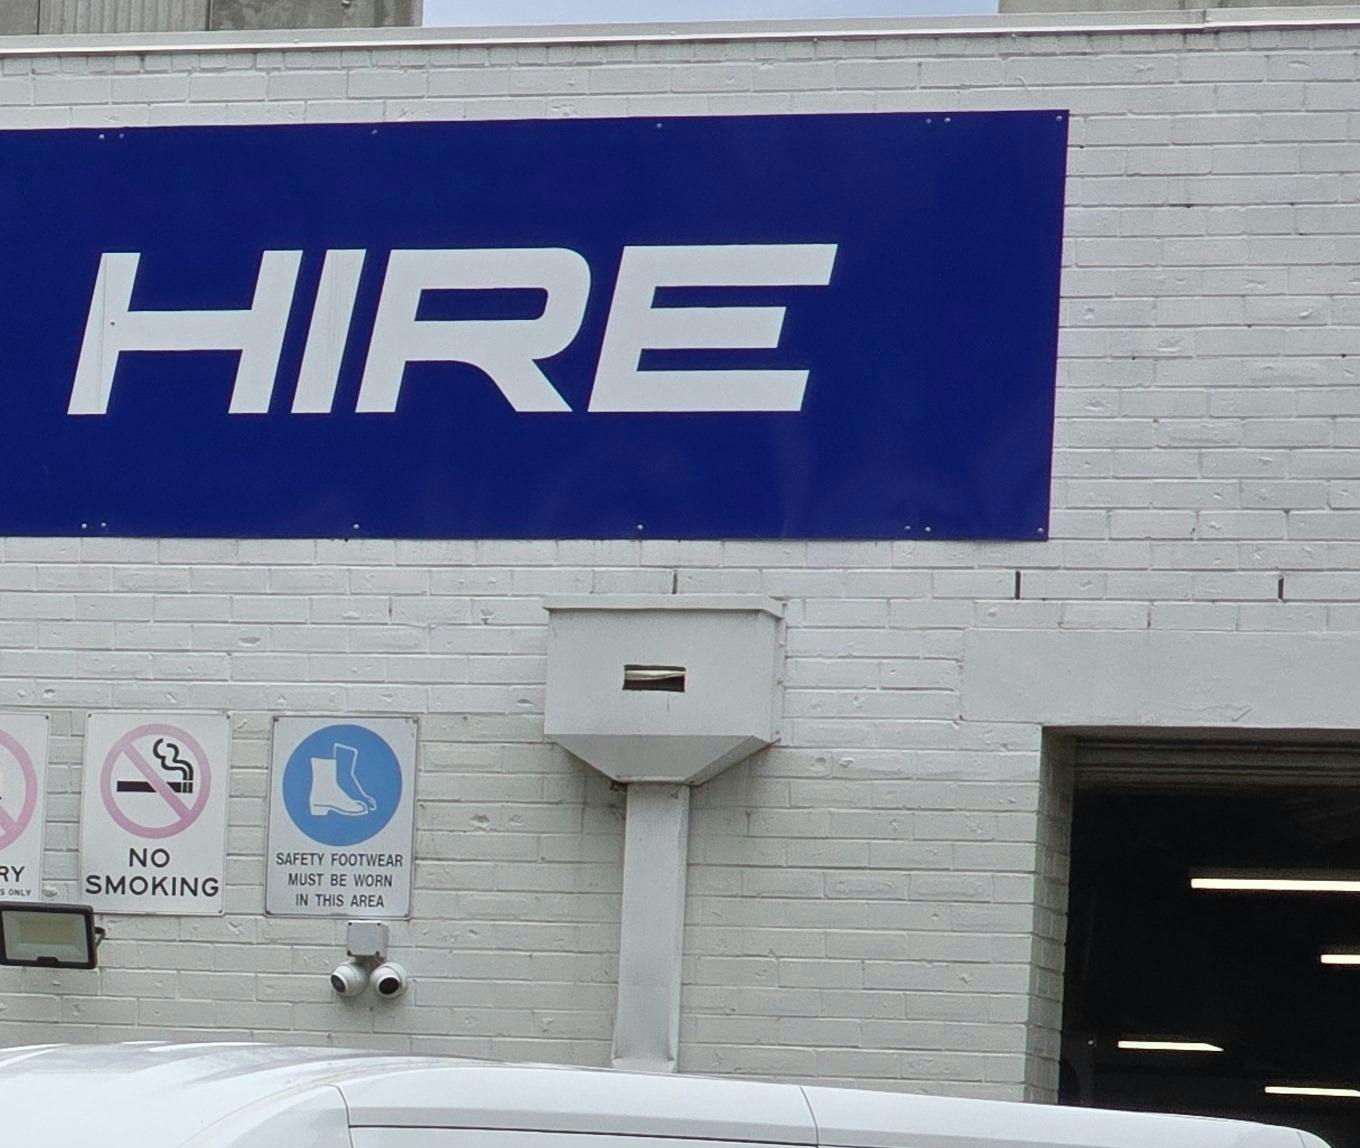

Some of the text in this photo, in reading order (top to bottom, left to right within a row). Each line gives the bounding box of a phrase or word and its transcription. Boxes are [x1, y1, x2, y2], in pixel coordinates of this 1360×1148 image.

[66, 243, 839, 414] HIRE
[129, 848, 170, 868] NO
[276, 852, 403, 867] SAFETY FOOTWEAR
[86, 875, 219, 897] SMOKING
[288, 873, 393, 887] MUST BE WORN
[8, 889, 32, 897] ONLY
[295, 893, 385, 908] IN THIS AREA
